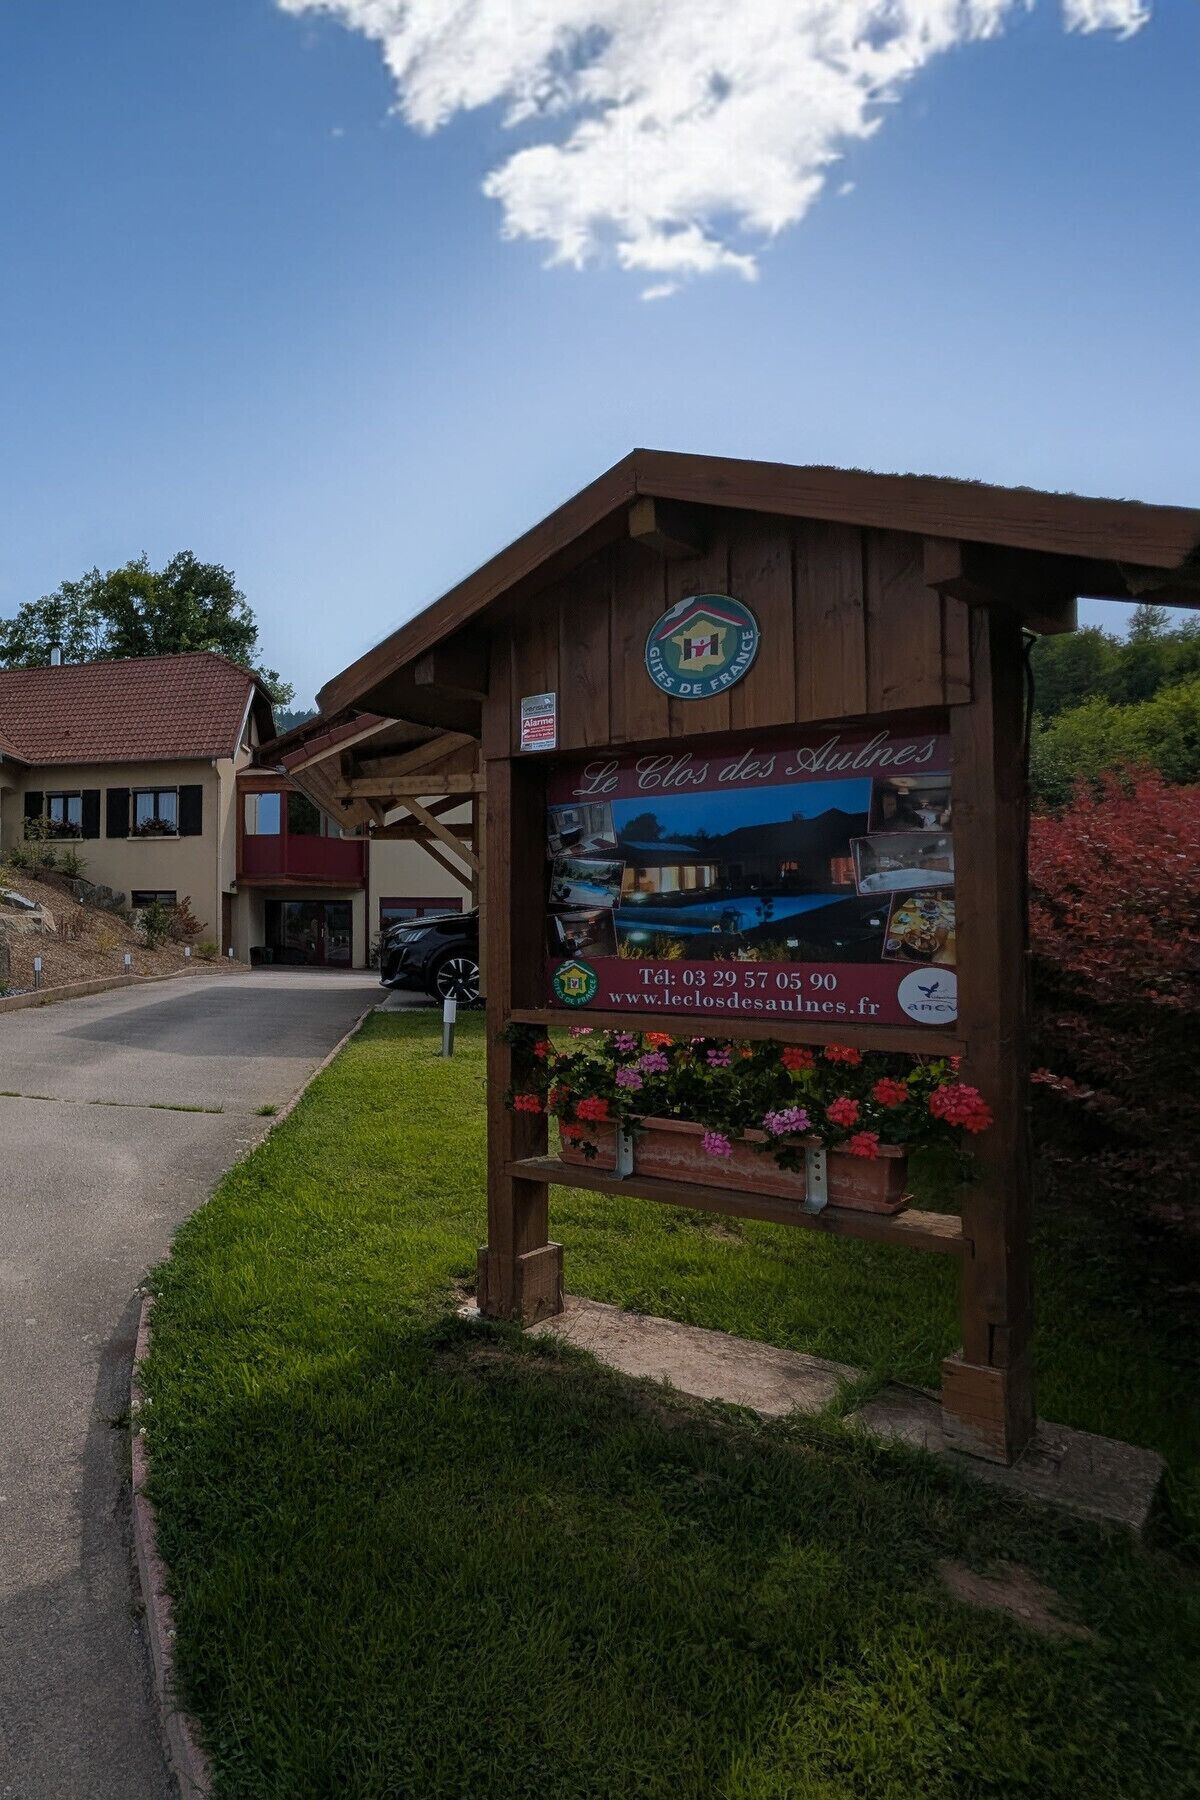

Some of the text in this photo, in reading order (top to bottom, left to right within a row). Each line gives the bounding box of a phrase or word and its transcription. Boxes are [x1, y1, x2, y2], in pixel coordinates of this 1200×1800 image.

[678, 683, 703, 694] DE
[709, 630, 754, 690] FRANCE
[524, 717, 554, 728] Alarme
[572, 729, 937, 796] Le Clos des Aulnes
[576, 979, 597, 1004] FRANCE
[639, 968, 838, 991] Tél: 03 29 57 05 90
[608, 990, 881, 1016] www.leclosdesaulnes.fr
